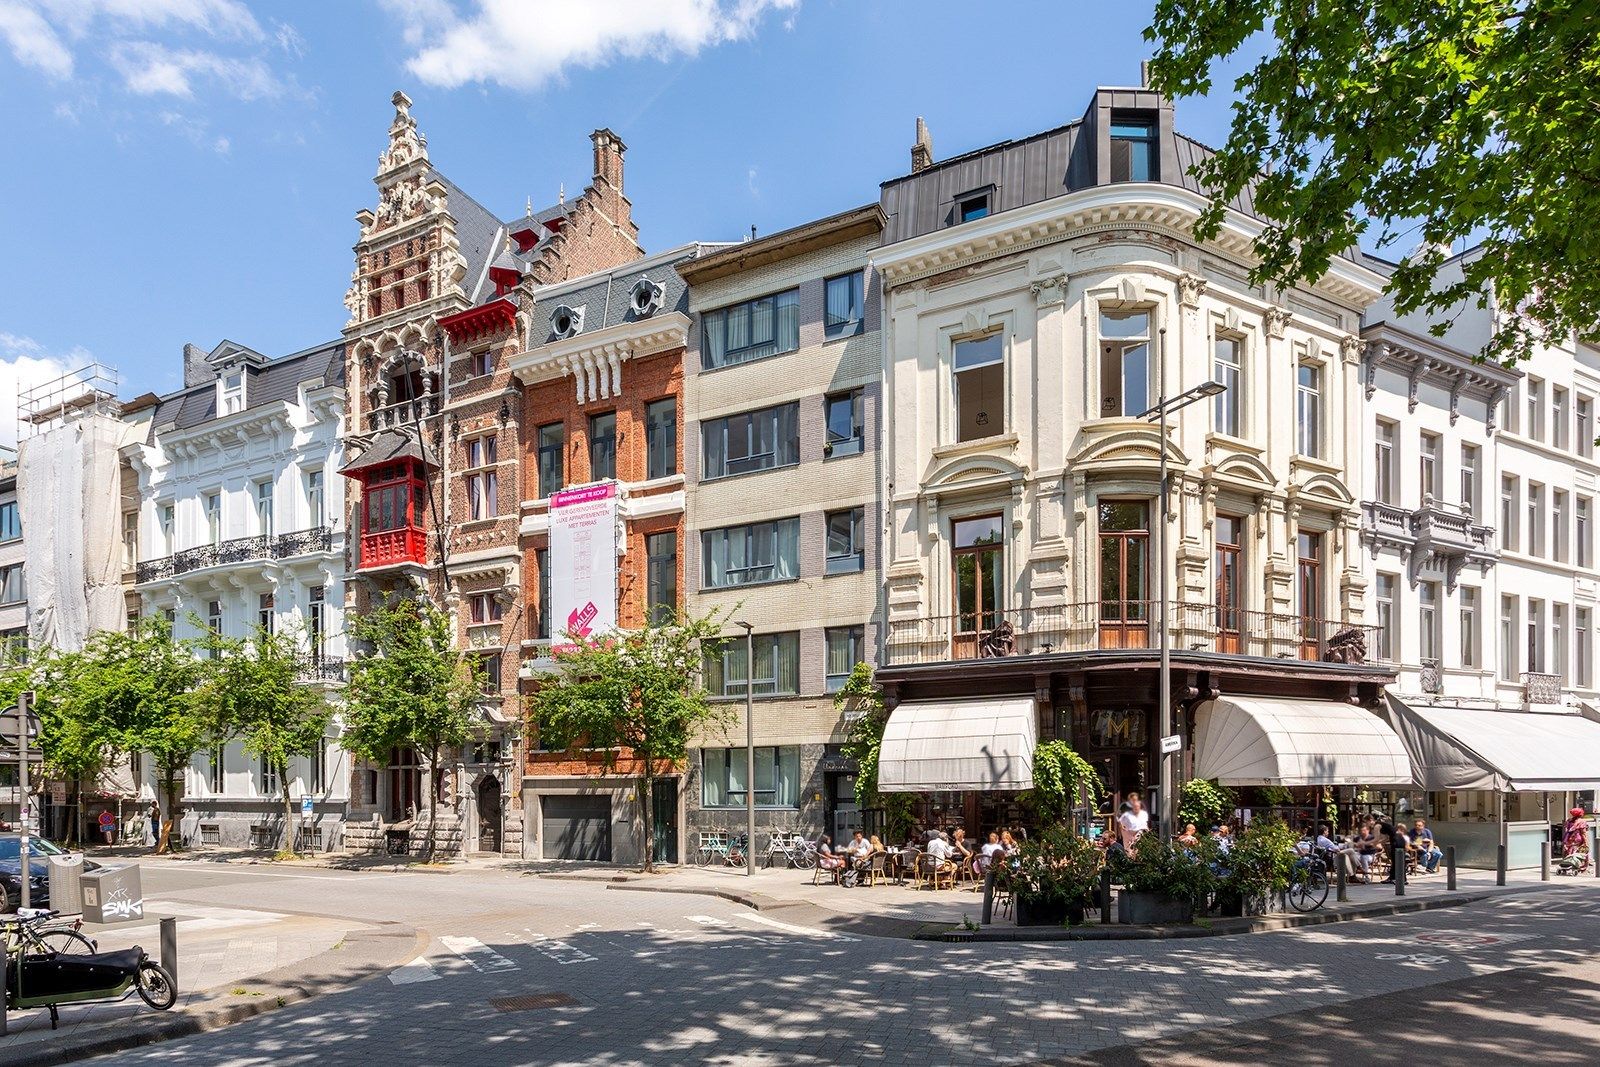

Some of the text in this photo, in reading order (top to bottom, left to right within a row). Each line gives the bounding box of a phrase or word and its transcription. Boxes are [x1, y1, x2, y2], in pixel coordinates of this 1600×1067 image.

[558, 493, 587, 502] BINNENKORT
[556, 509, 610, 524] LUXE APPARTEMENTEN
[579, 519, 597, 528] TERRAS
[570, 604, 595, 633] WALLS
[1107, 718, 1129, 738] M
[102, 898, 144, 917] SMK
